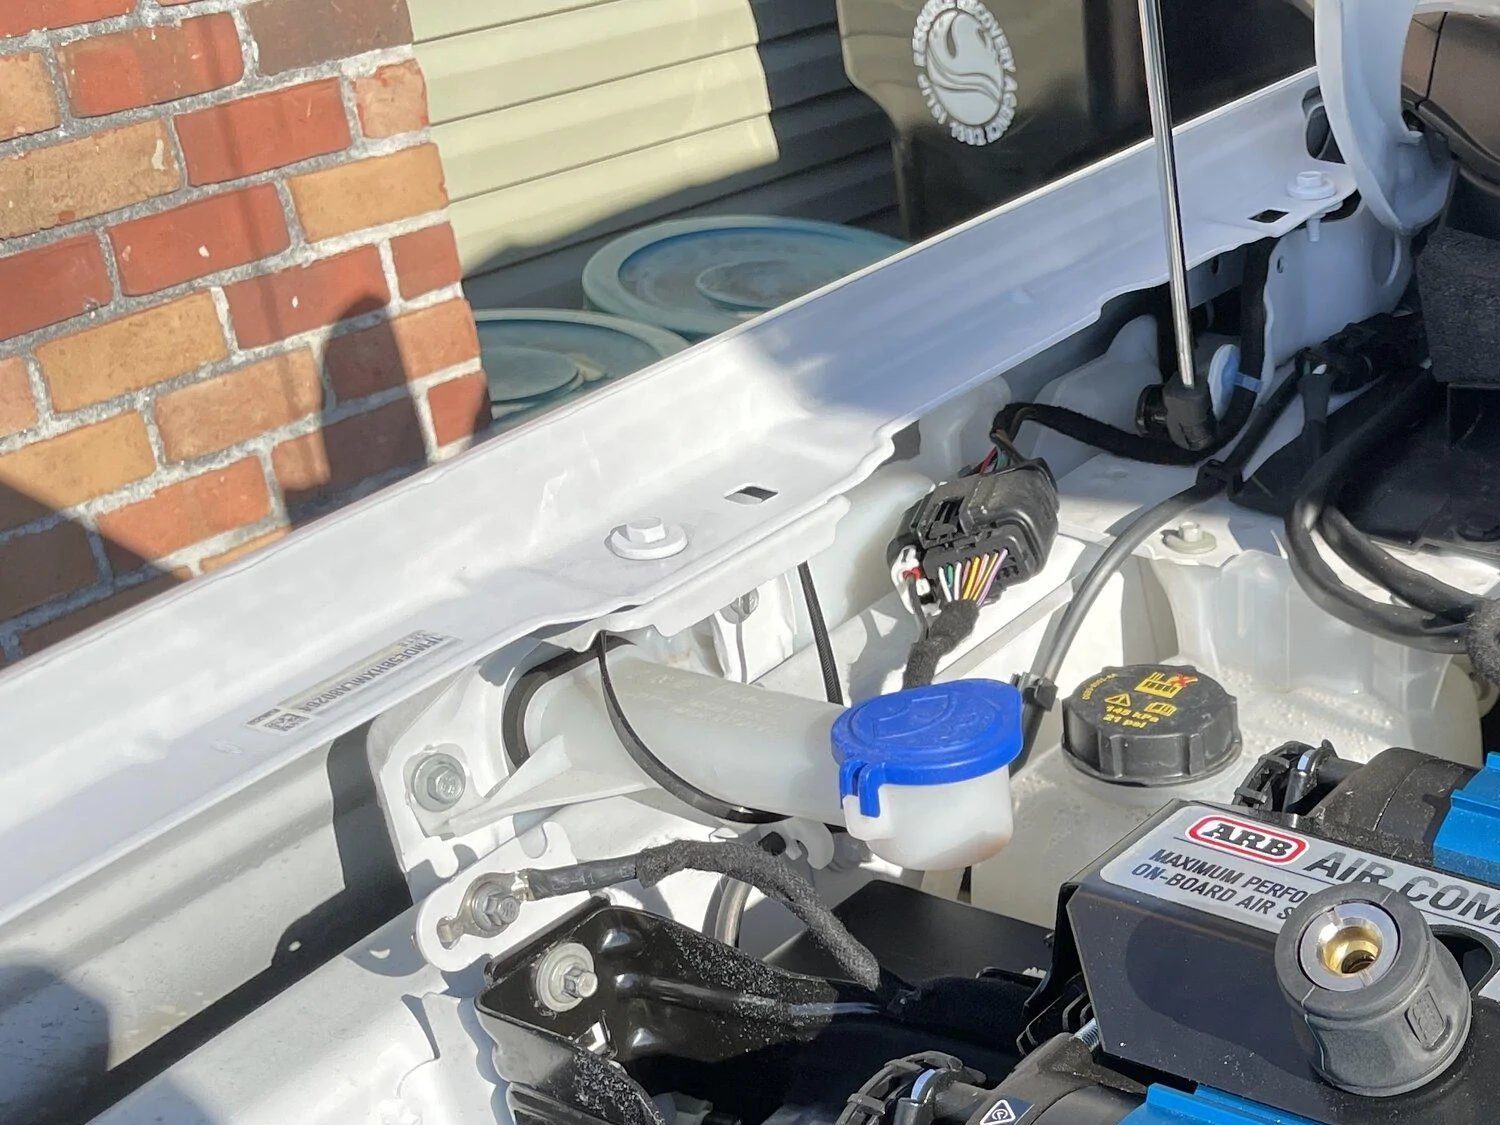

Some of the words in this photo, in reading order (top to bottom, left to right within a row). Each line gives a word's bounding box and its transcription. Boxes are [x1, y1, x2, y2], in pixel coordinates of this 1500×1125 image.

[1201, 822, 1295, 857] ARB
[1148, 848, 1245, 885] MAXIMUM
[1303, 850, 1394, 885] AIR
[1131, 863, 1238, 902] ON-BOARD
[1236, 894, 1277, 915] AIR
